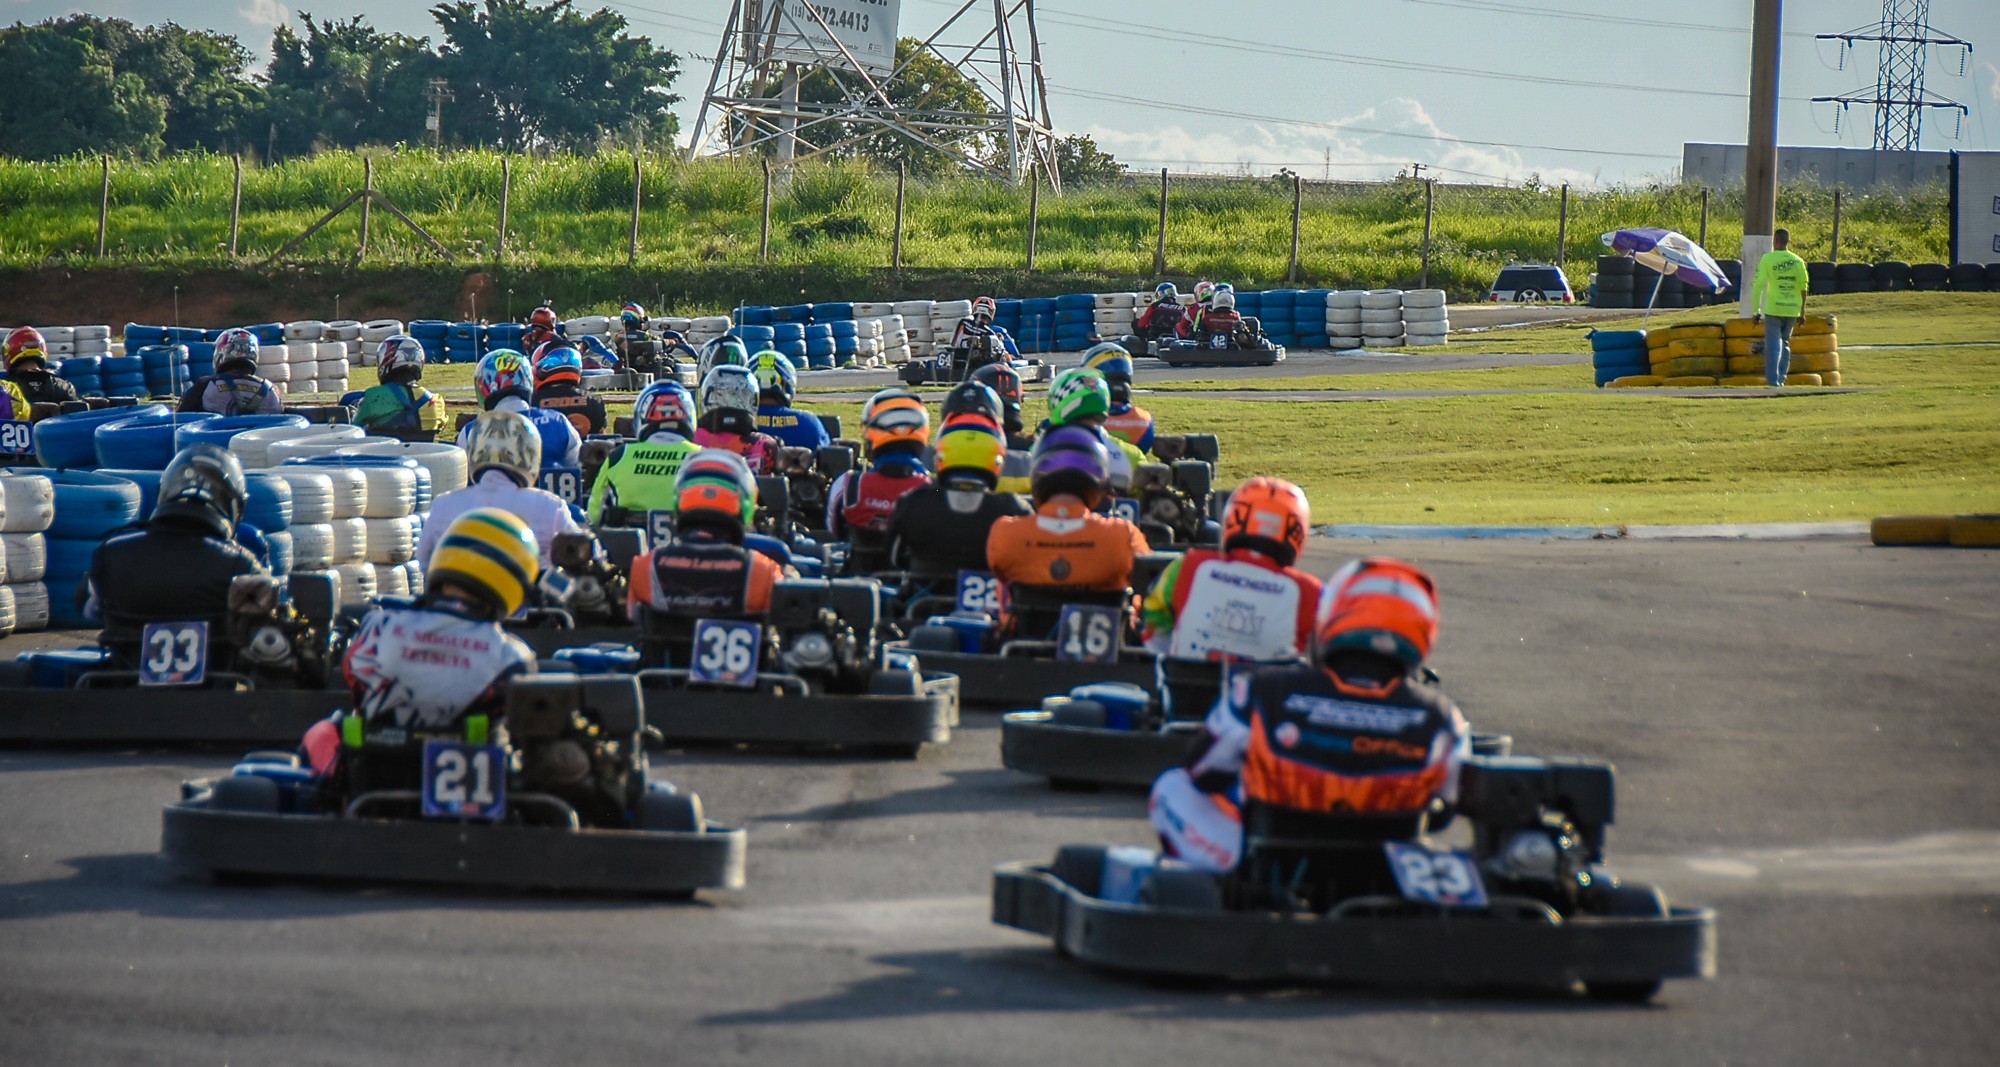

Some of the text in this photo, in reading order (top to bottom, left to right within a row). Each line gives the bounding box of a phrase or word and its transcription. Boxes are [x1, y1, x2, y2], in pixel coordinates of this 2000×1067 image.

[1211, 335, 1226, 346] 42
[938, 352, 952, 367] 64
[539, 397, 588, 408] CROCE
[1, 423, 30, 449] 20
[544, 472, 576, 504] 18
[962, 575, 999, 610] 22
[700, 626, 753, 674] 36
[1064, 610, 1112, 656] 16
[148, 629, 199, 673] 33
[434, 748, 494, 805] 21
[1399, 851, 1473, 897] 23
